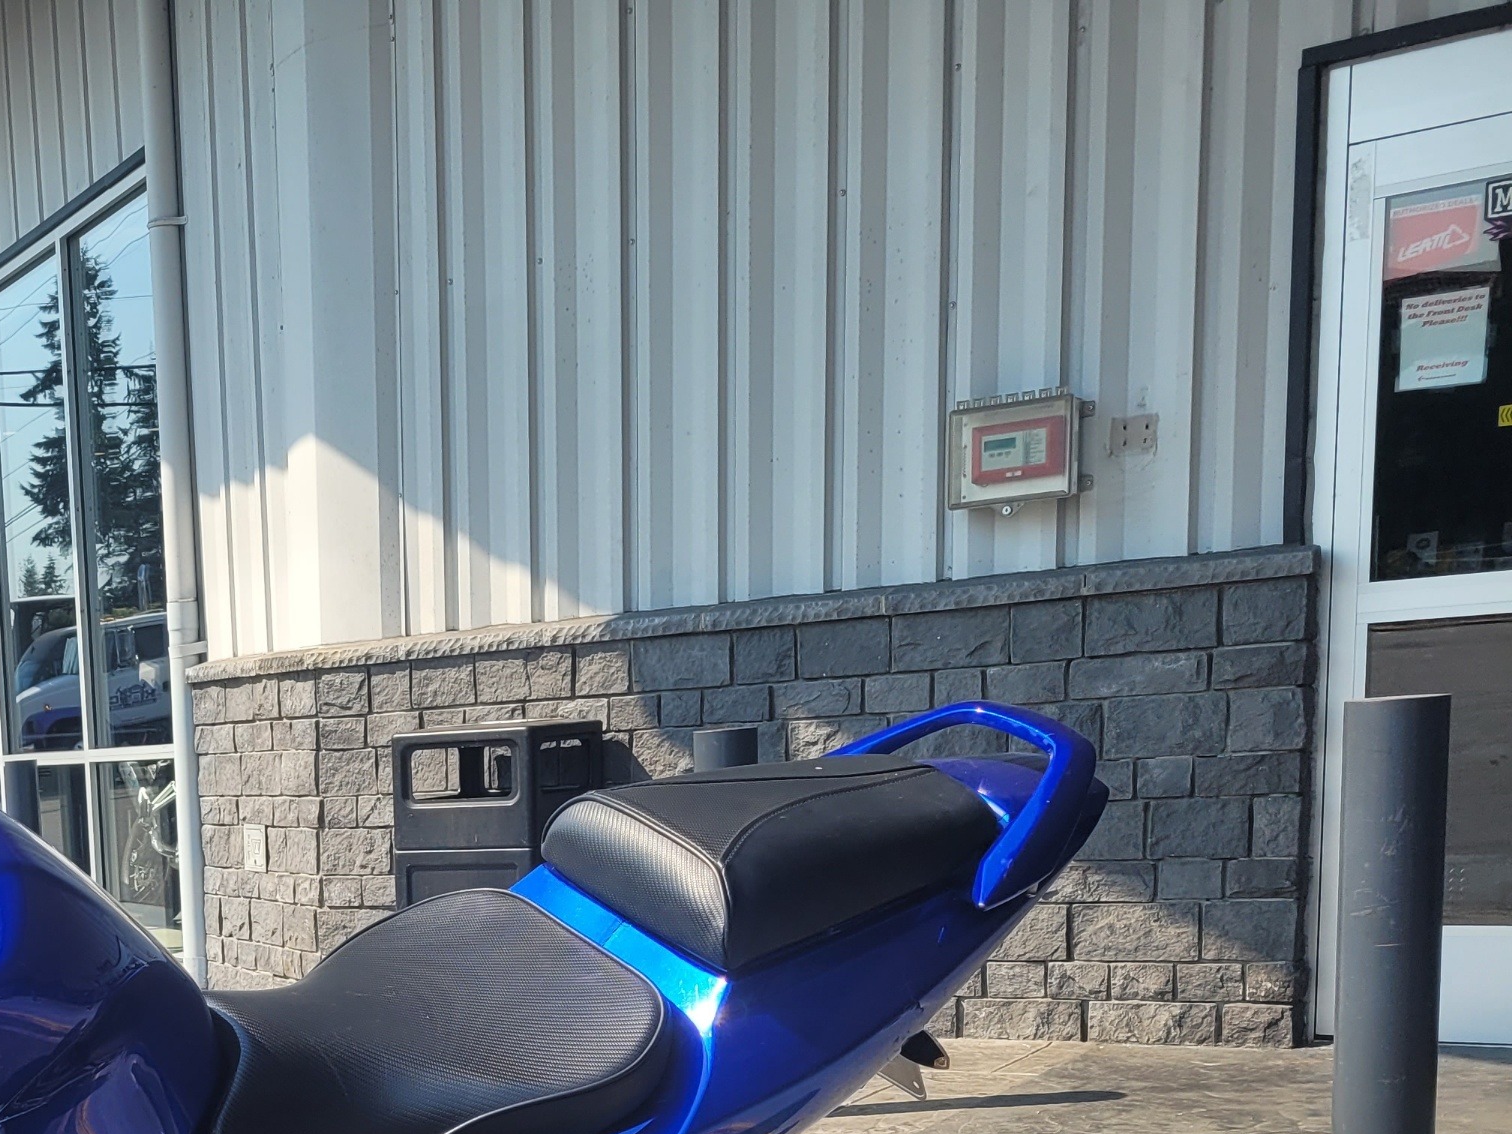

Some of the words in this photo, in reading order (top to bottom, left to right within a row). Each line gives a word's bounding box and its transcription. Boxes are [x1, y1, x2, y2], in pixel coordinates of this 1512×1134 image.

[1421, 296, 1473, 308] deliveries
[1426, 309, 1455, 318] Front
[1456, 303, 1483, 313] Desk
[1416, 360, 1469, 372] Receiving
